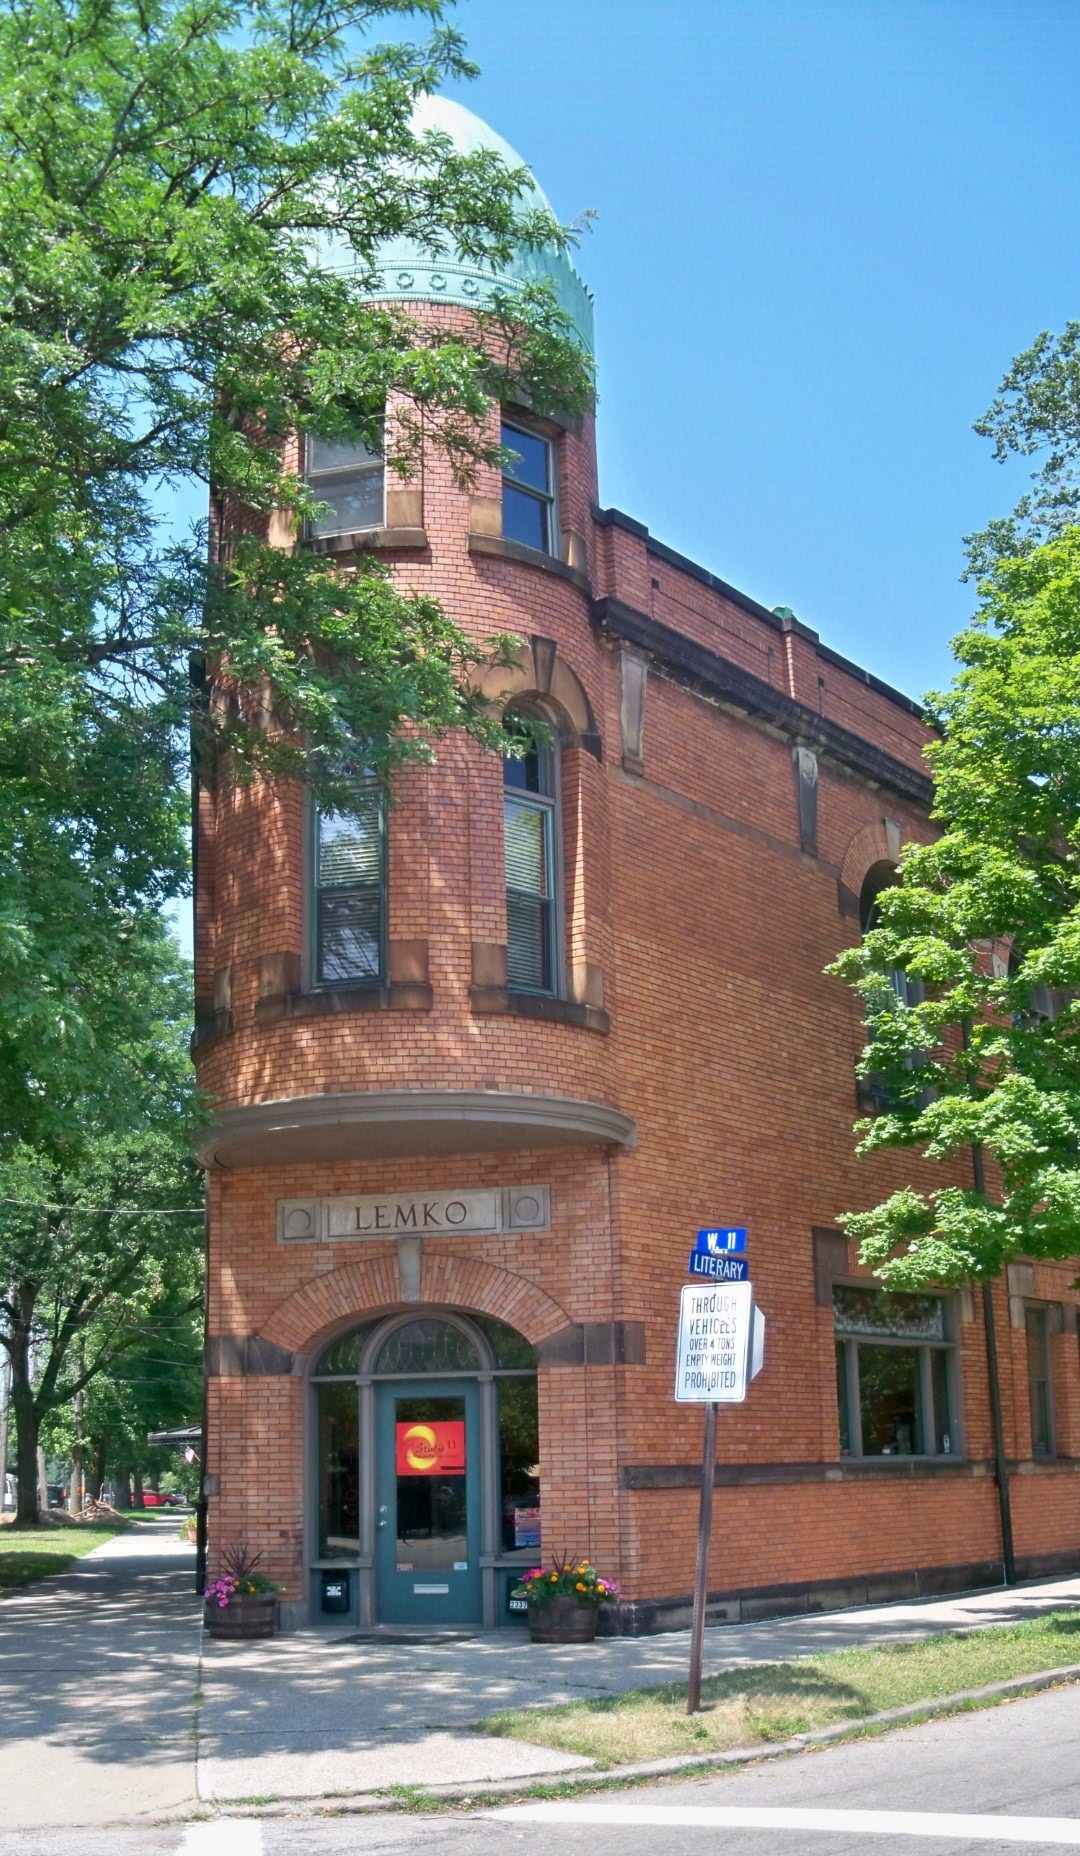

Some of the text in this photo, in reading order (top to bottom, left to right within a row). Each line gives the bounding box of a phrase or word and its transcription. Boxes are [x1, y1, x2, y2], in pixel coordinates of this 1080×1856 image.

[354, 1201, 467, 1231] LEMKO
[727, 1232, 736, 1249] 11
[694, 1254, 744, 1280] LITERARY
[691, 1296, 738, 1313] THROUGH
[689, 1317, 738, 1335] VEHICLES
[689, 1337, 735, 1351] OVER 4 TONS
[686, 1353, 737, 1366] EMPTY WEIGHT
[684, 1371, 736, 1389] PROHIBITED
[415, 1442, 445, 1453] Studio
